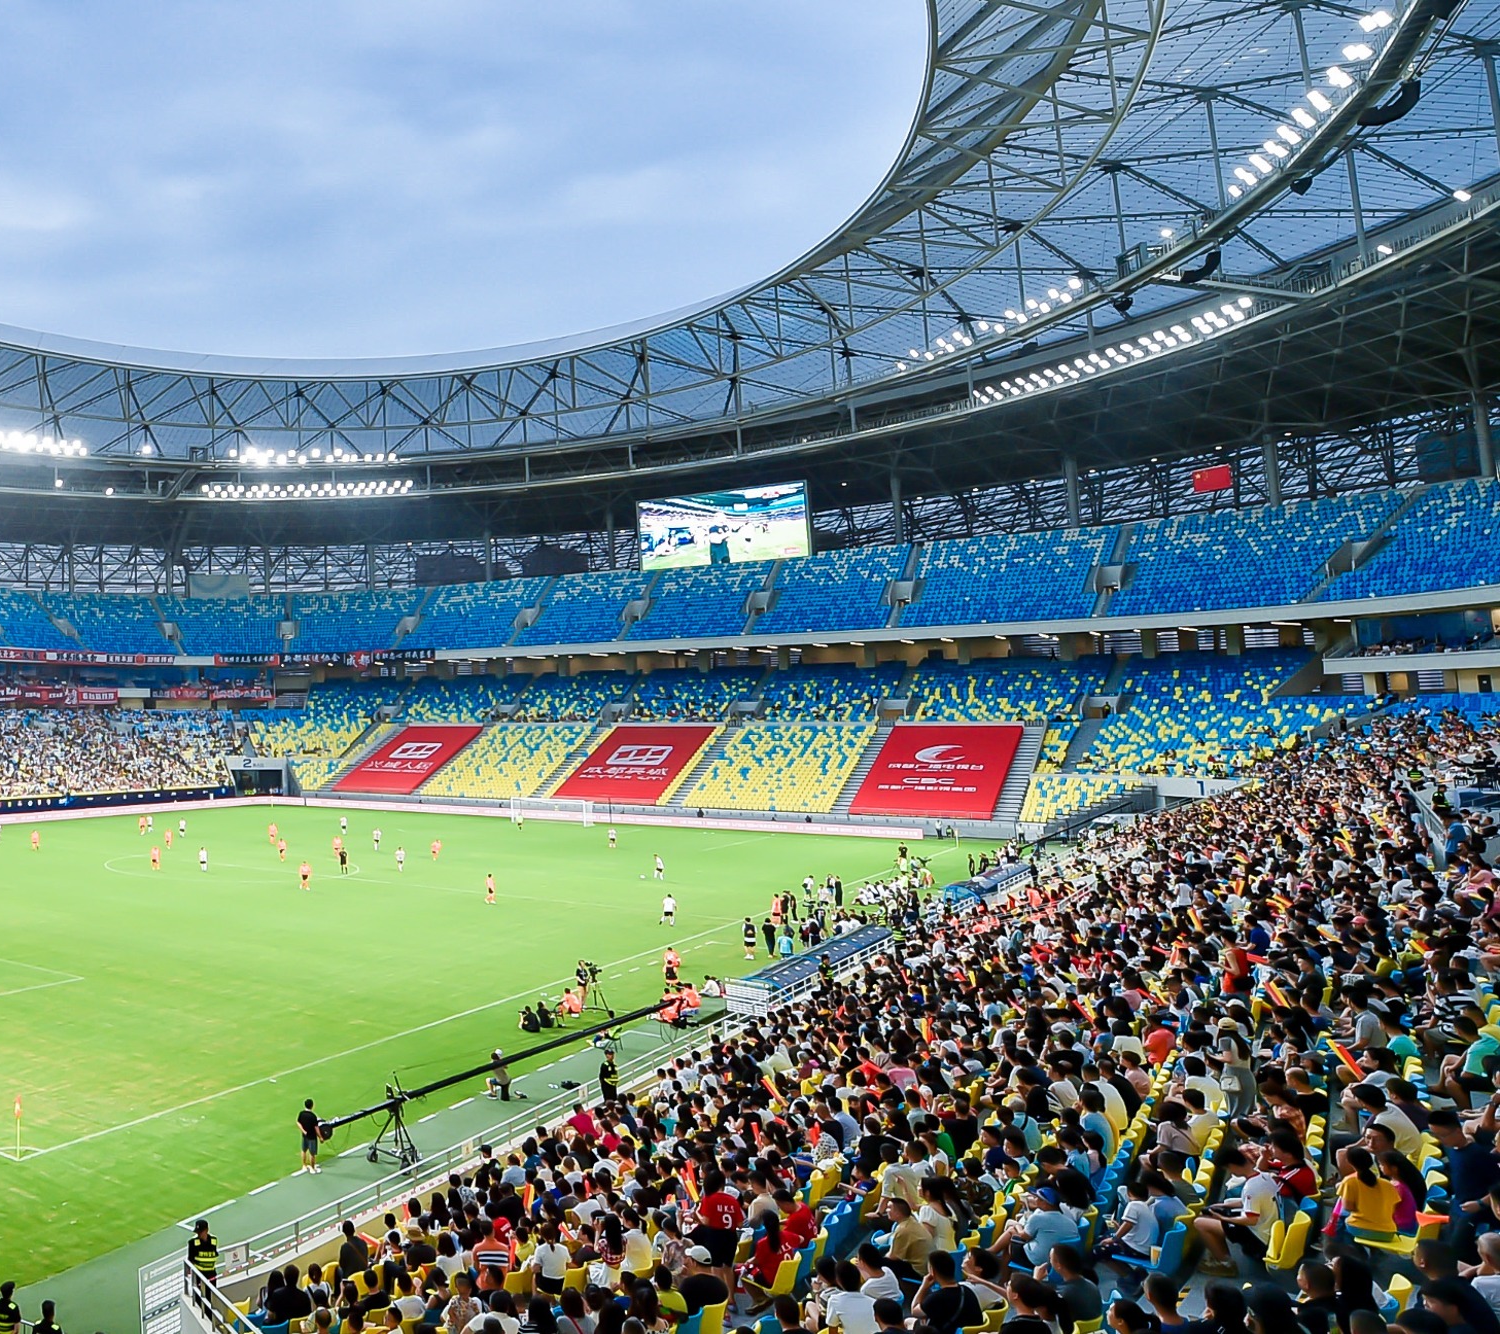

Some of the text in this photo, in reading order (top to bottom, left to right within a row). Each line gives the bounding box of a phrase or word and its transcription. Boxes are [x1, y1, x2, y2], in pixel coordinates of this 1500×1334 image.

[243, 759, 252, 768] 2
[365, 761, 434, 770] 兴城人居
[888, 763, 984, 771] 成都广播电视台
[1197, 780, 1205, 796] 1
[722, 1213, 733, 1229] 9
